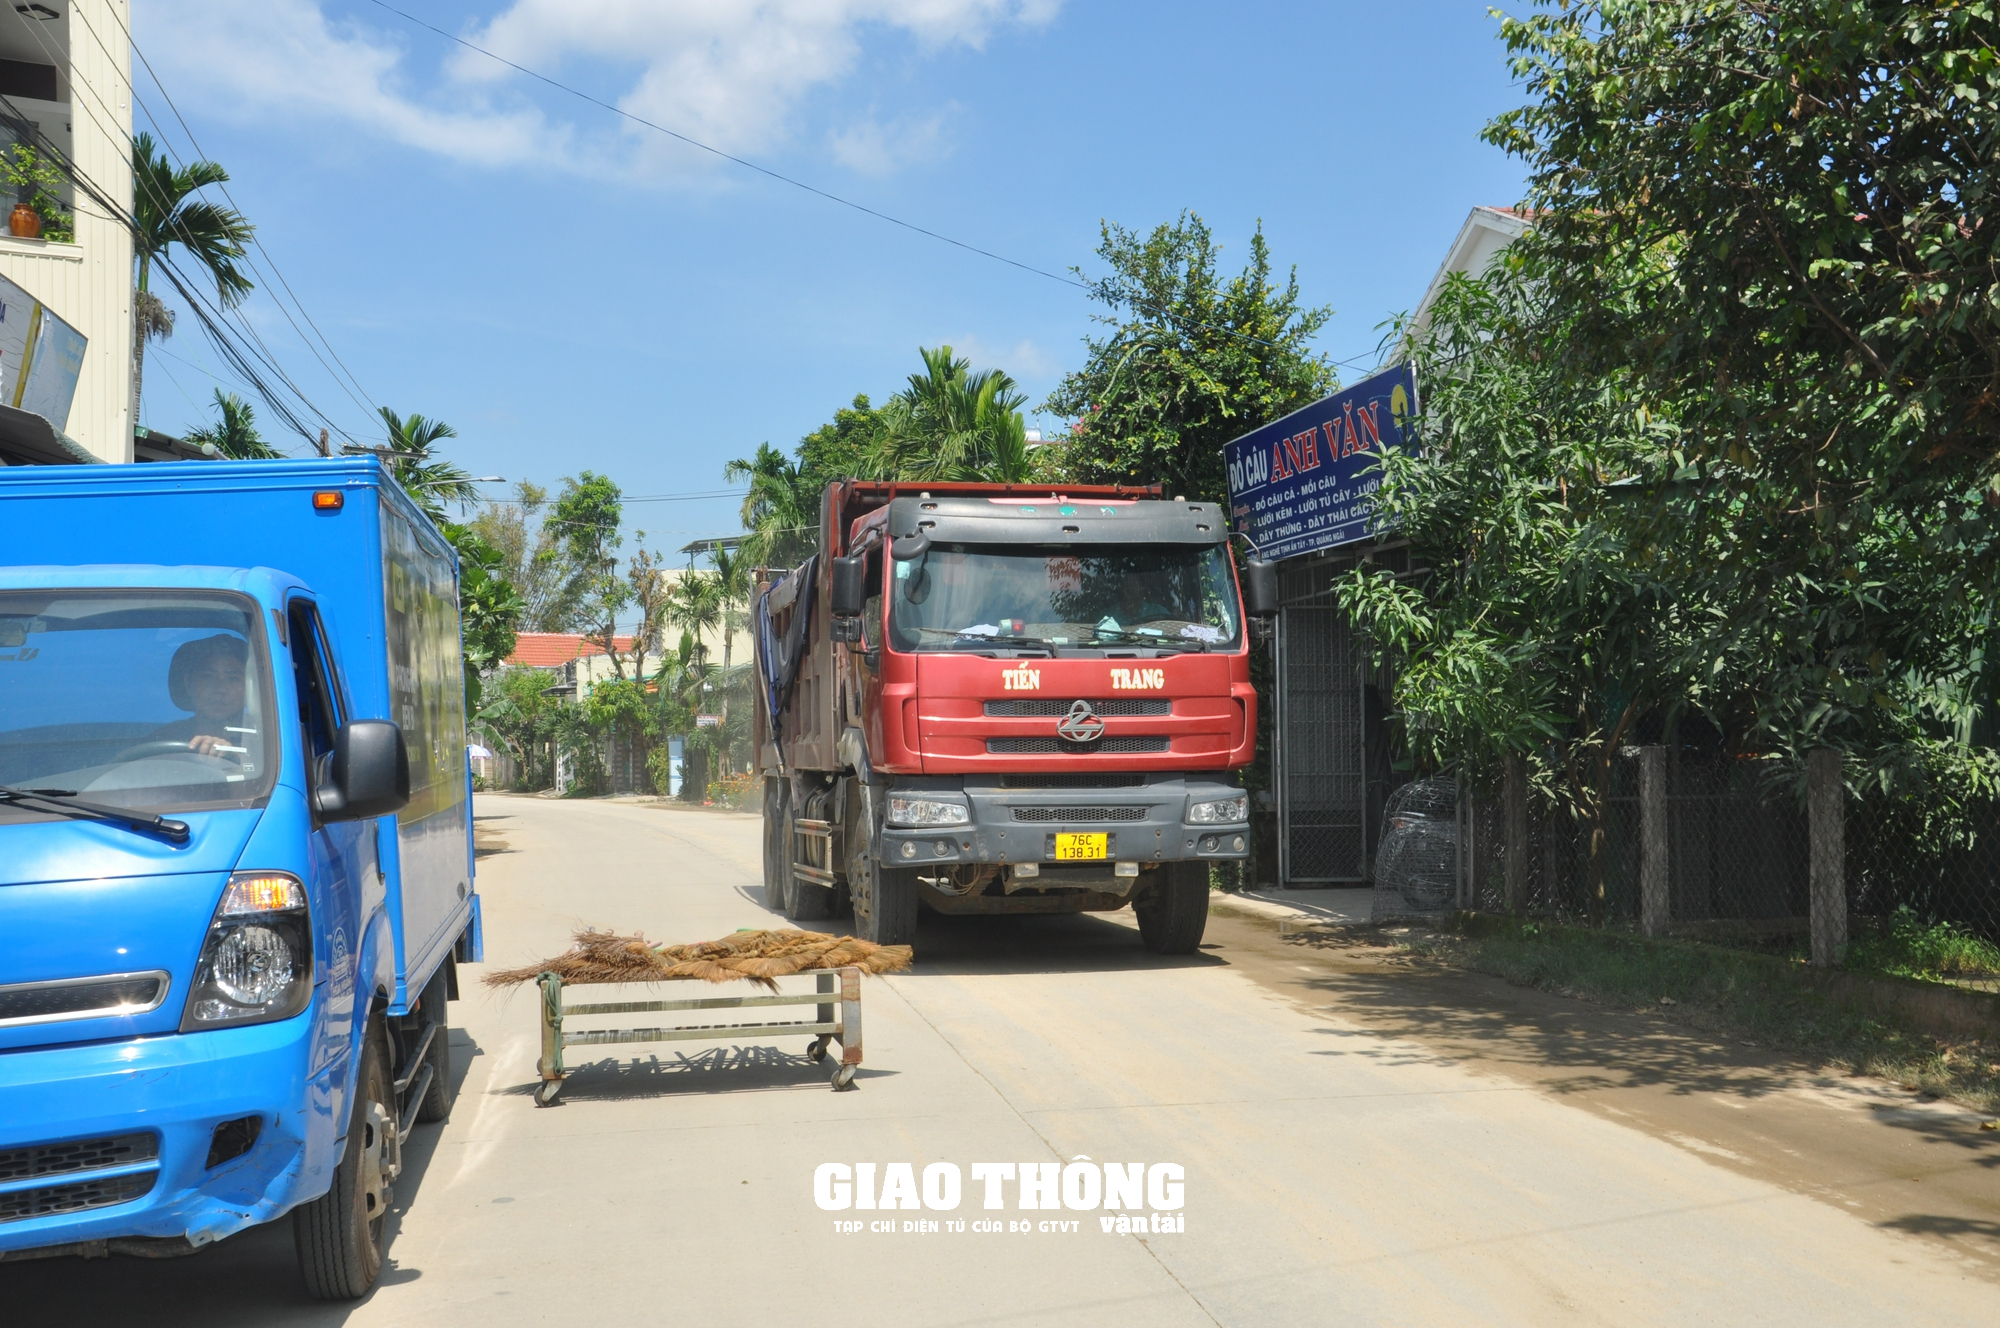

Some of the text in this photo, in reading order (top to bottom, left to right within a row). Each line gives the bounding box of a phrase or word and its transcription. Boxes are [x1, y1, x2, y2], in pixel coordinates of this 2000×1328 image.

[1229, 399, 1379, 493] ĐỒ CÂU ANH VĂN
[1267, 492, 1283, 507] CÂU
[1284, 486, 1296, 501] CÁ
[1318, 475, 1337, 491] CÂU
[1332, 488, 1351, 505] CÂY
[1258, 529, 1274, 544] DÂY
[1307, 514, 1325, 530] DÂY
[1326, 507, 1349, 525] THÁI
[1002, 660, 1165, 691] TIẾN TRANG
[1062, 847, 1100, 858] 138.31
[1071, 834, 1093, 846] 76C
